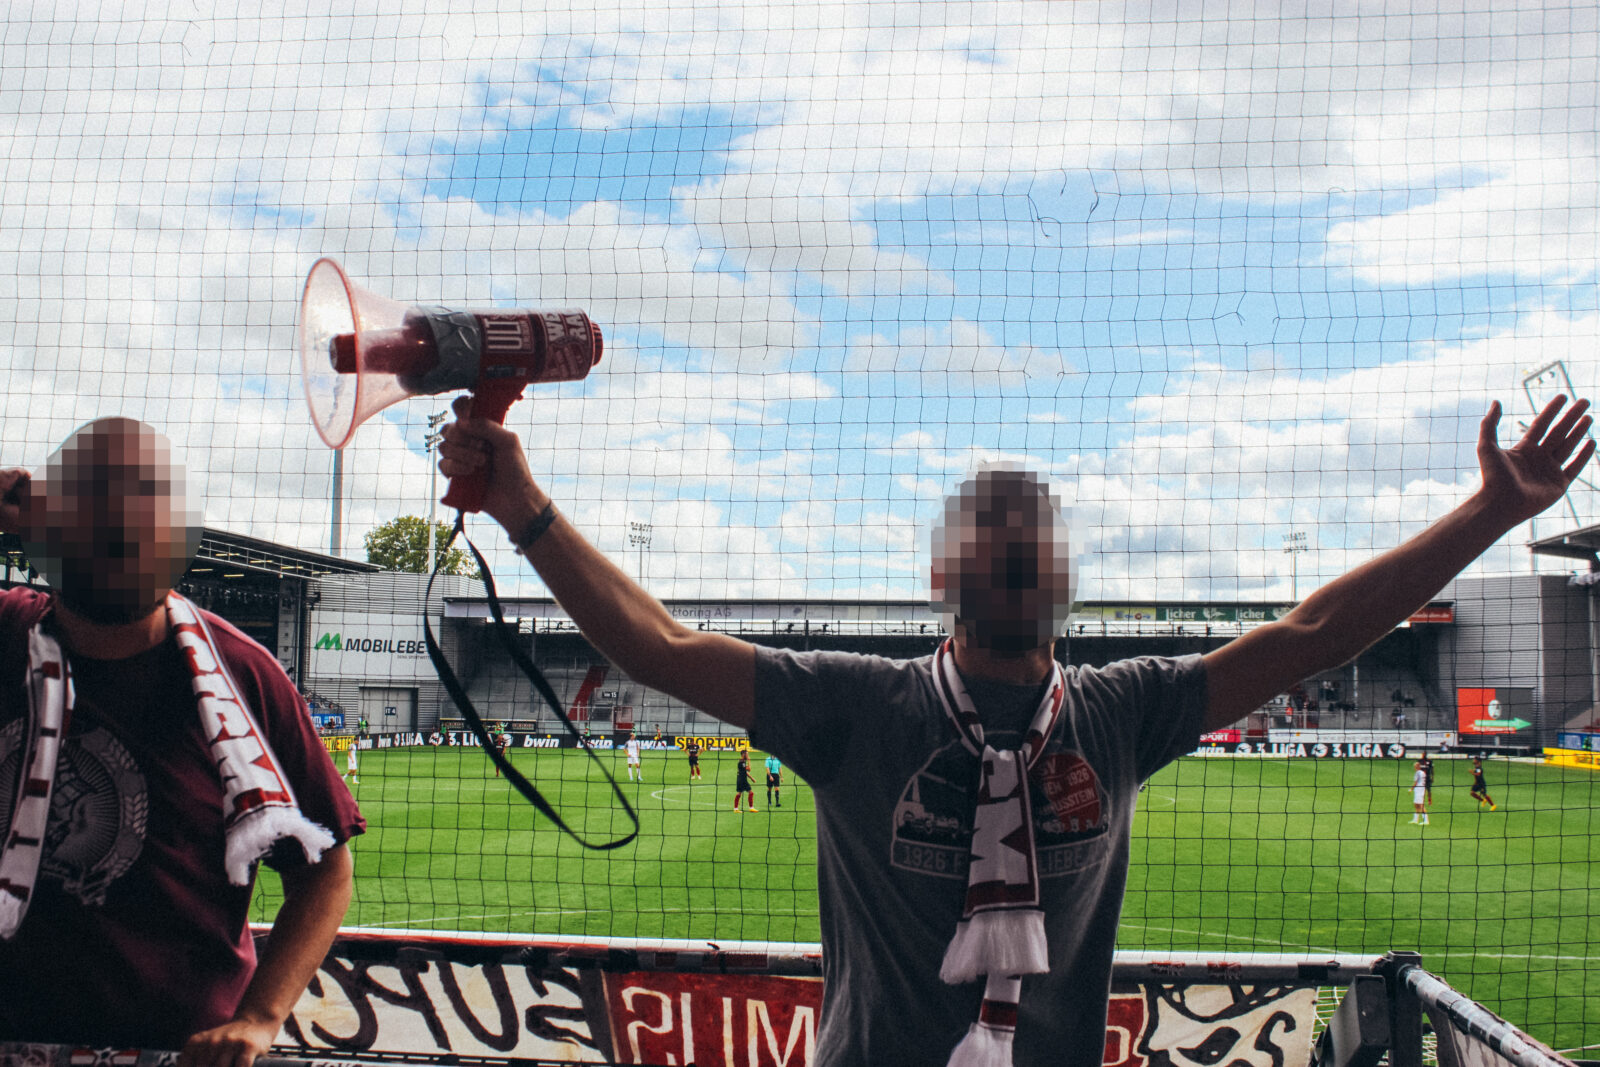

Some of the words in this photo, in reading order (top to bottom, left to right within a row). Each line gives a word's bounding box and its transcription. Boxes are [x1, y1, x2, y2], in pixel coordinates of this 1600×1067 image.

[669, 607, 711, 618] ctoring
[714, 607, 732, 617] AG
[345, 638, 427, 654] MOBILEBE
[523, 734, 560, 748] bwin
[1332, 743, 1346, 757] 3.
[1348, 743, 1384, 757] LIGA
[1068, 767, 1089, 787] 1926
[902, 845, 946, 873] 1926
